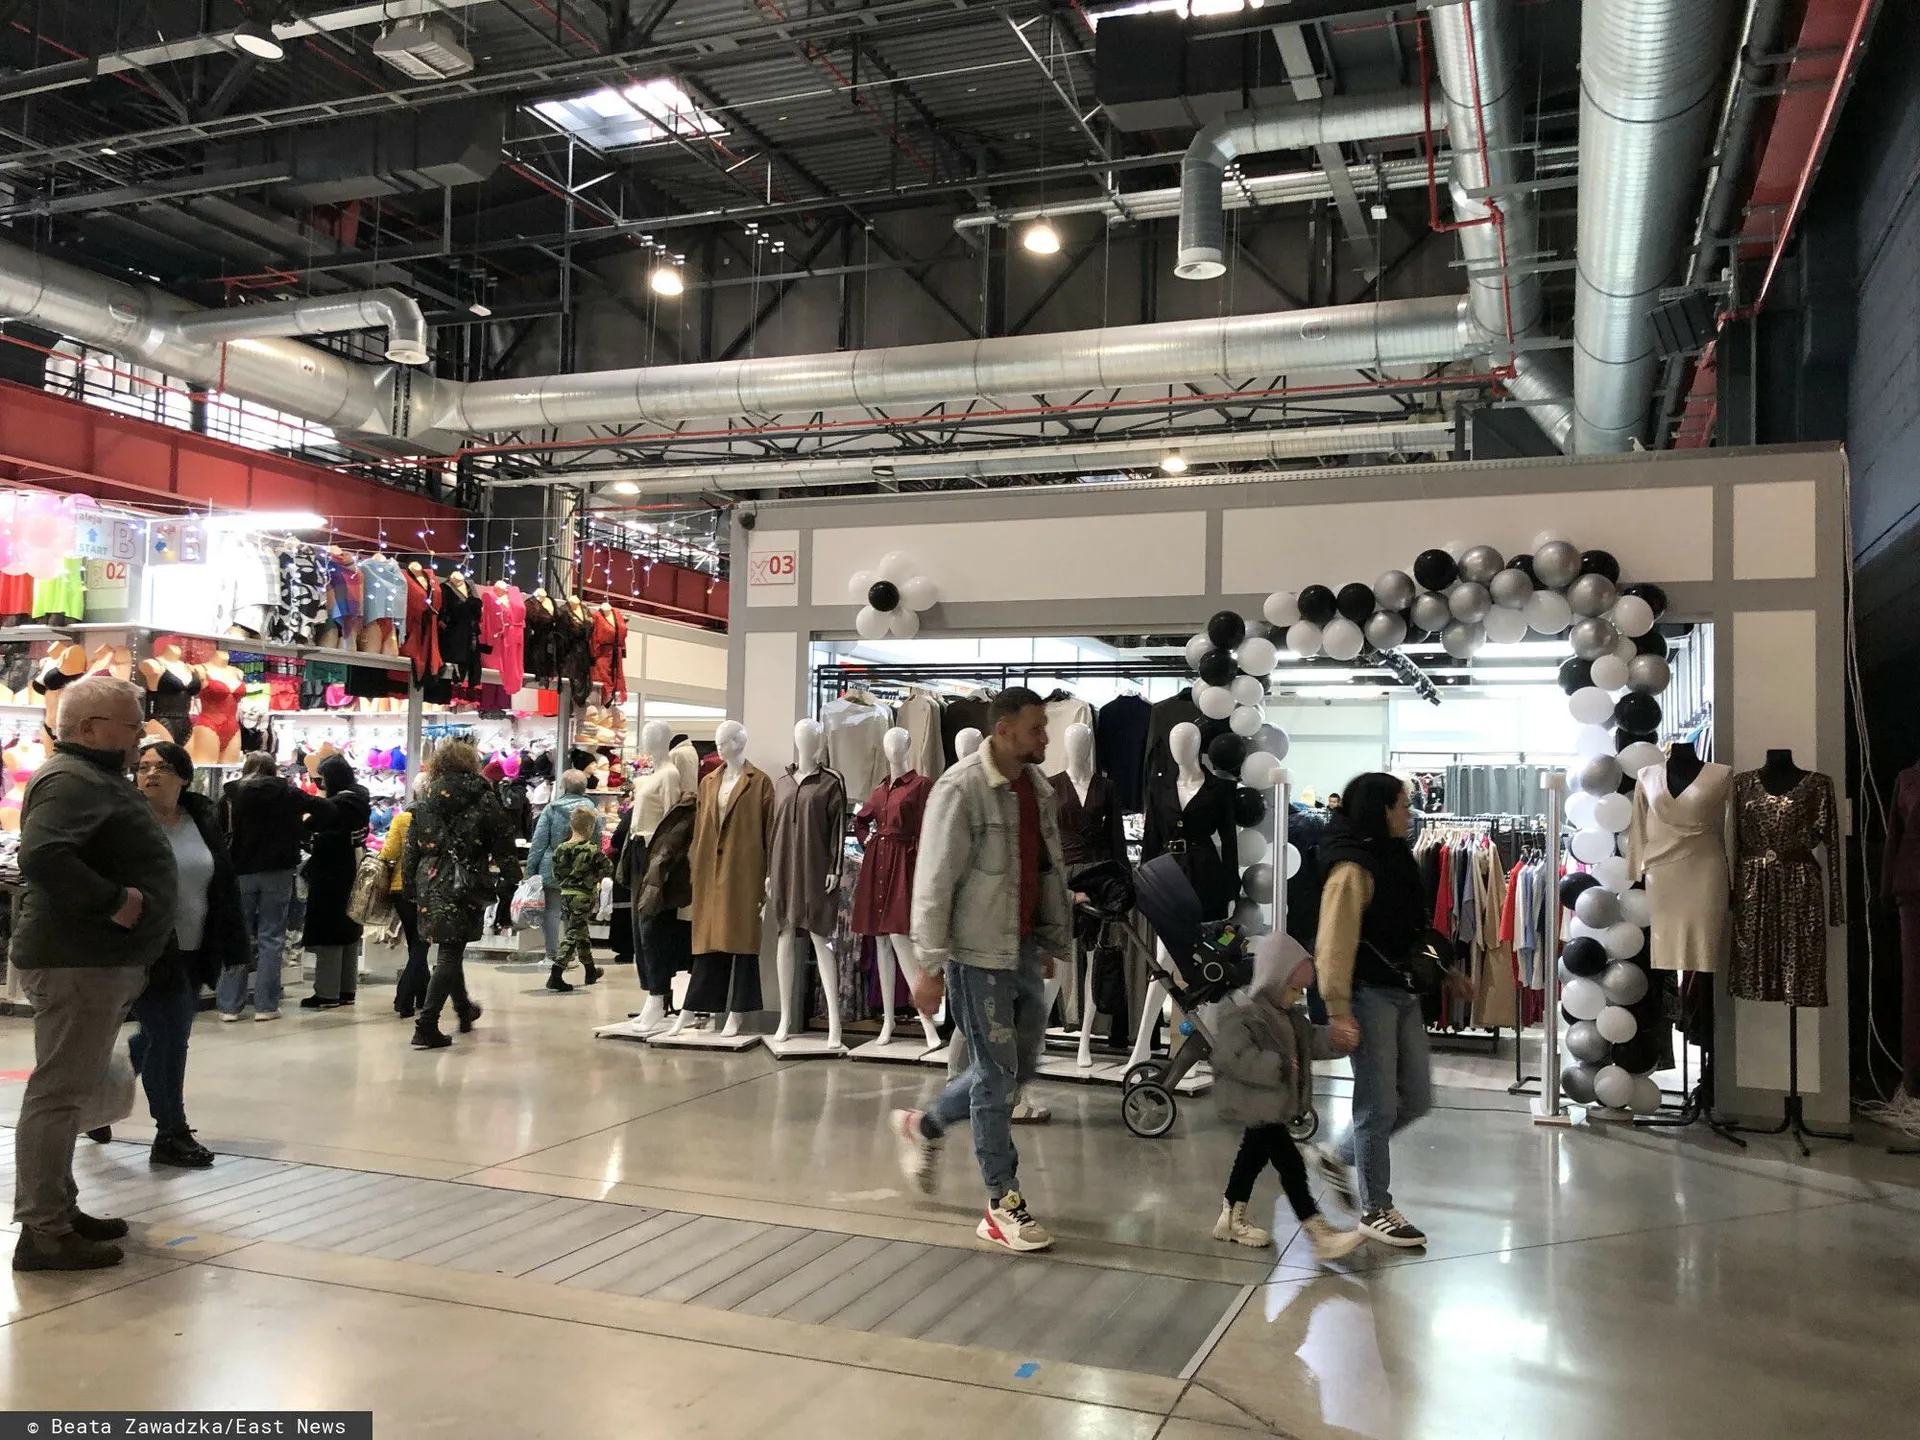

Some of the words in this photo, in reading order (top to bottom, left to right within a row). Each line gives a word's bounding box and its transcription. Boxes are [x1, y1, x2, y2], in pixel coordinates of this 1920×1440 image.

[113, 519, 136, 560] B
[79, 544, 108, 556] START
[106, 562, 126, 580] 02
